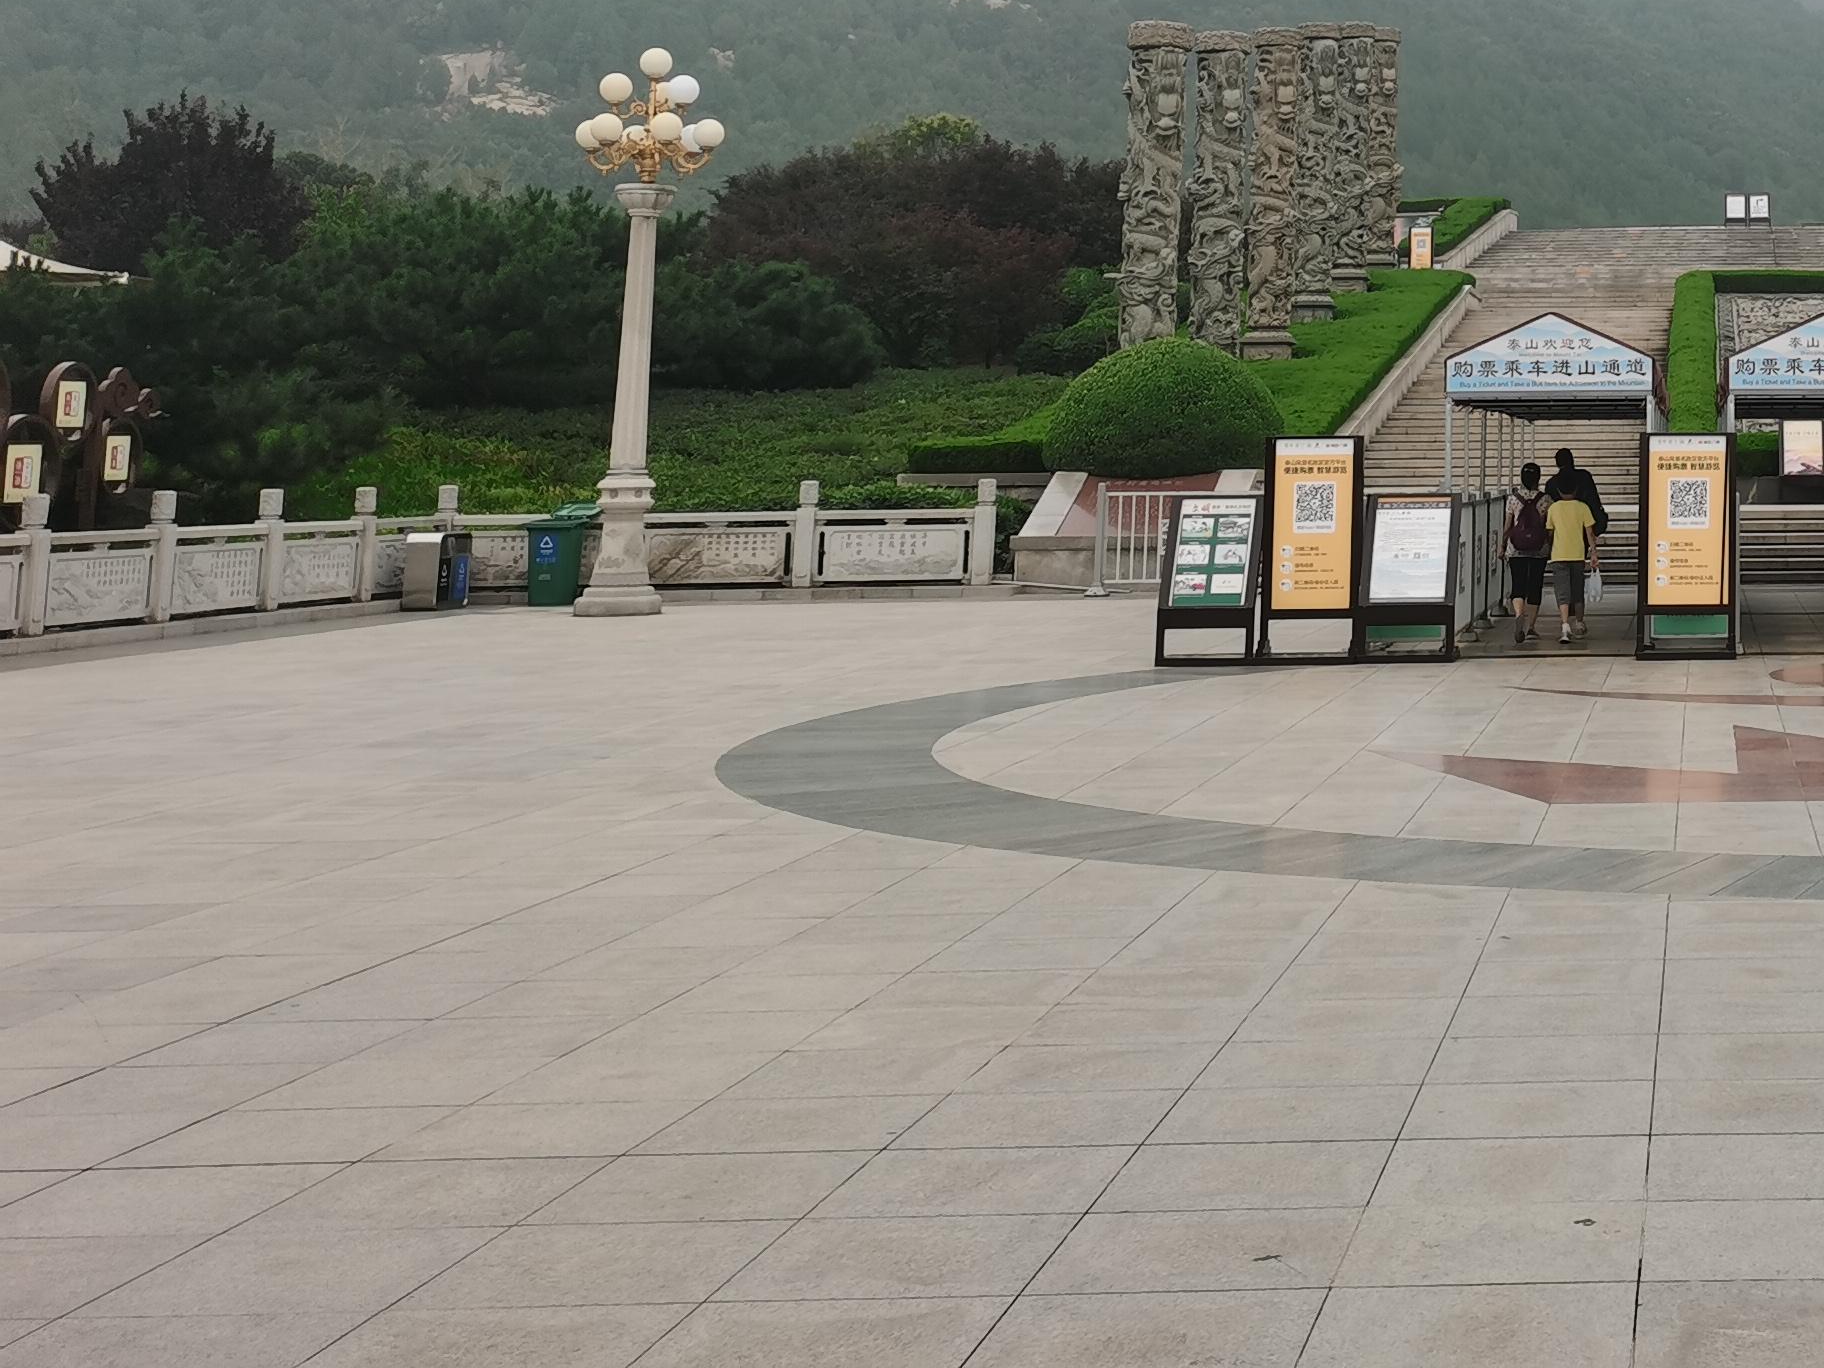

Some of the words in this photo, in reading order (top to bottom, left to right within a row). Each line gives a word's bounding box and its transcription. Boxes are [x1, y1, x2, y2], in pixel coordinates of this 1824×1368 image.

[1507, 338, 1594, 351] 泰山欢迎您
[1452, 358, 1647, 378] 购票乘车进山通道
